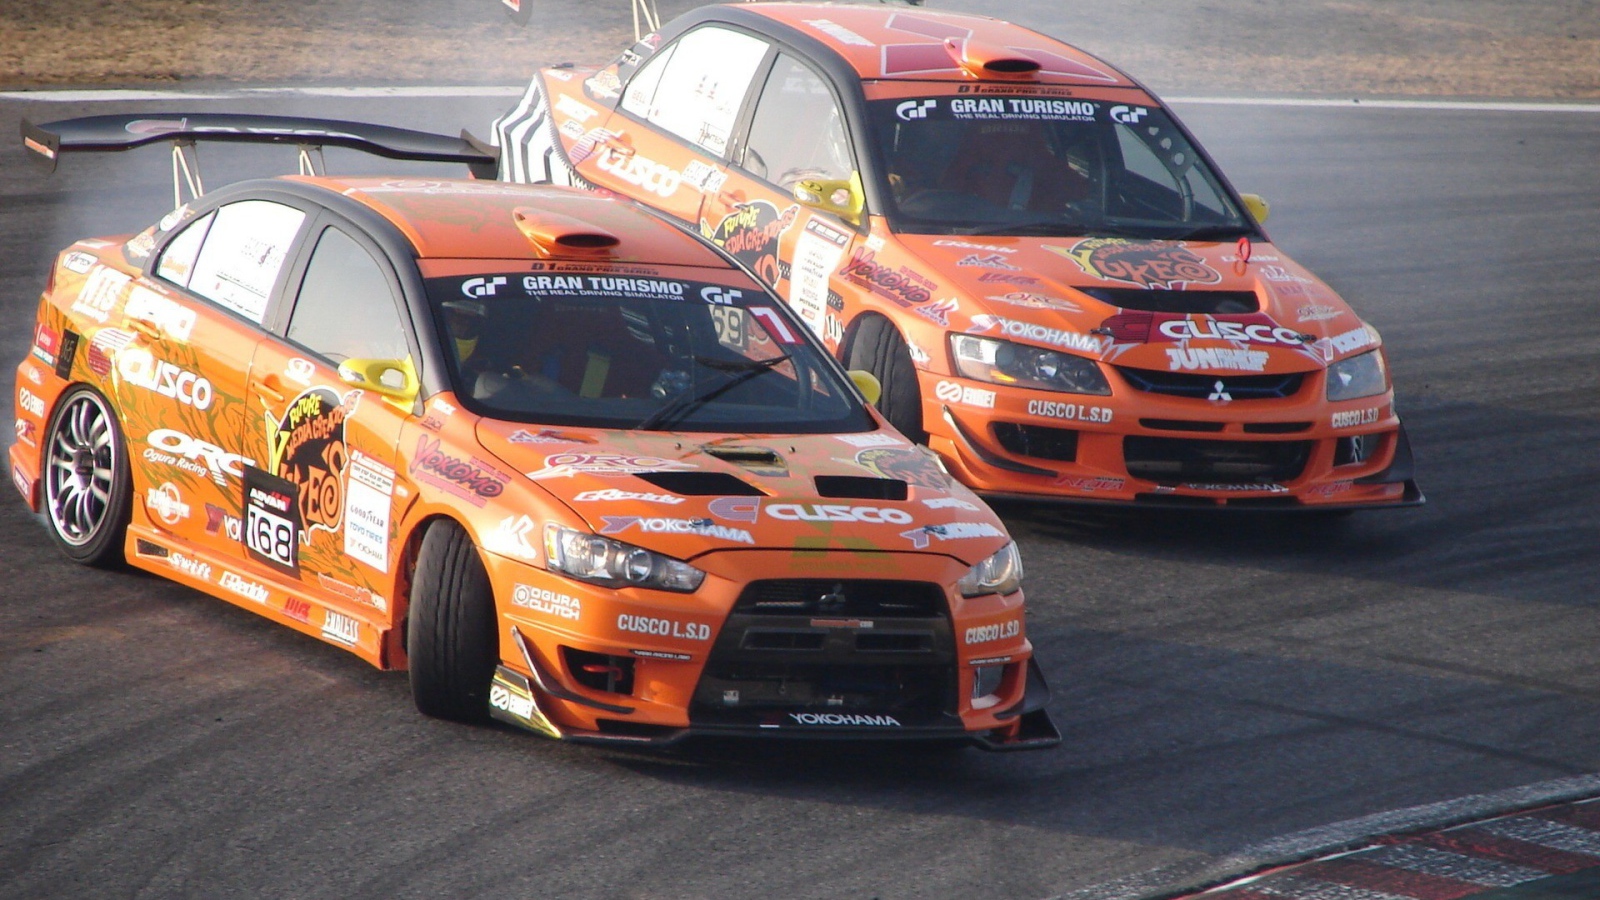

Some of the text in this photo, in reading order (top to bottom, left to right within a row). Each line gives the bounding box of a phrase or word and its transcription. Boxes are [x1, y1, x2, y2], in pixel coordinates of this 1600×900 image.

[951, 99, 1095, 117] GRAN TURISMO
[1002, 113, 1040, 121] DRIVING
[1041, 114, 1096, 122] SIMULATOR
[523, 276, 684, 296] GRAN TURISMO
[548, 290, 574, 298] REAL
[575, 291, 623, 300] DRIVING
[624, 292, 685, 301] SIMULATOR
[1000, 317, 1101, 354] YOKOHAMA
[1159, 319, 1303, 345] CUSCO
[289, 393, 322, 429] FUTURE
[1028, 399, 1113, 423] CUSCO L.S.D
[1331, 409, 1361, 429] CUSCO
[143, 448, 207, 477] Ogura Racing
[147, 429, 256, 487] ORC
[250, 487, 287, 513] ADVAN
[350, 504, 384, 528] GOODYEAR
[764, 504, 913, 525] CUSCO
[250, 510, 291, 563] 168
[638, 518, 755, 545] YOKOHAMA
[169, 552, 211, 580] Swift
[529, 599, 580, 621] CLUTCH
[530, 587, 581, 609] OGURA
[617, 614, 711, 640] CUSCO L.S.D
[965, 619, 1020, 645] CUSCO L.S.D
[789, 713, 901, 726] YOKOHAMA
